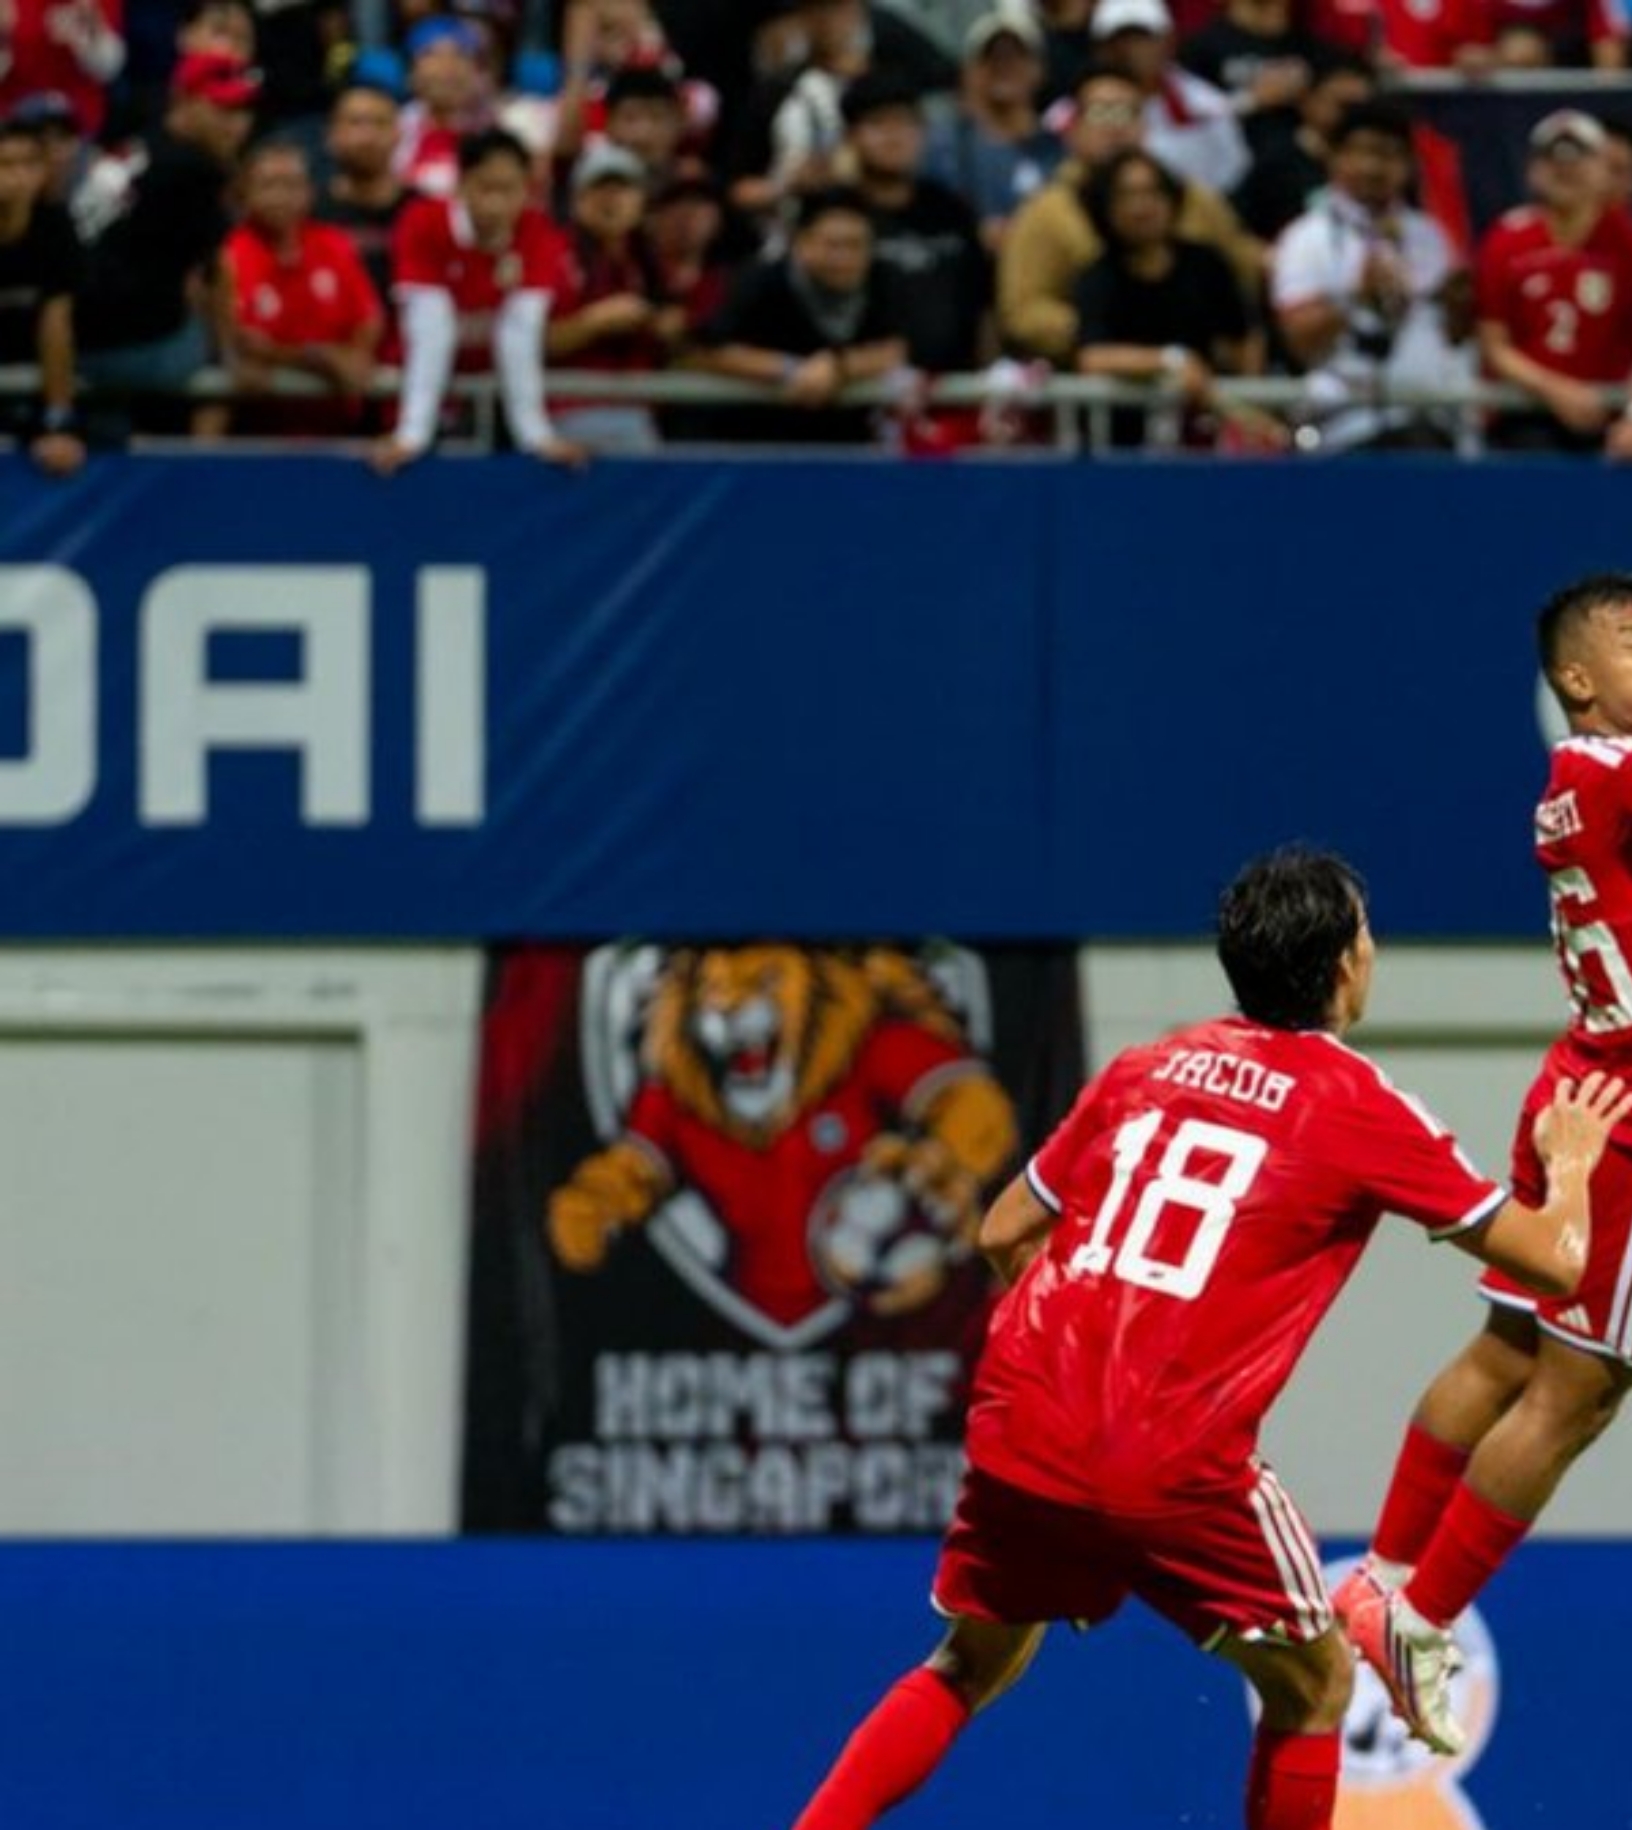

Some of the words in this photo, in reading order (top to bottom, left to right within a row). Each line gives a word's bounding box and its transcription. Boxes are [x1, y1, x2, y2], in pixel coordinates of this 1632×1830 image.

[1152, 1048, 1297, 1113] JACOB
[1066, 1105, 1270, 1302] 18
[593, 1350, 838, 1442] HOME
[843, 1350, 962, 1442] OF
[547, 1440, 972, 1534] SINGAPOR
